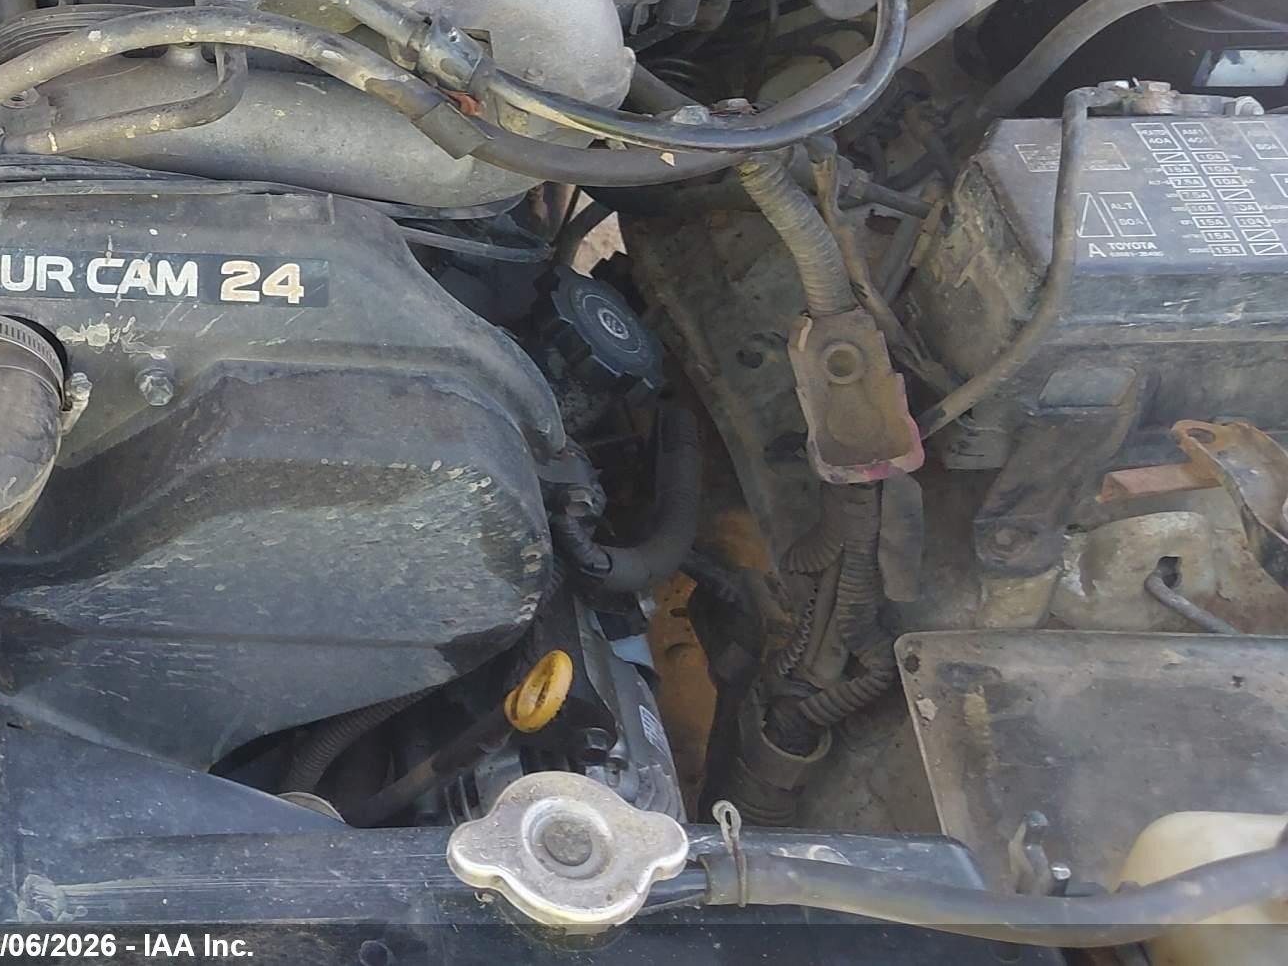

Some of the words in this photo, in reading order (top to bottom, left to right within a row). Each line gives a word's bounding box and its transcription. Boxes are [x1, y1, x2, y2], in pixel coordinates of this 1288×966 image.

[1207, 232, 1232, 240] 15A
[1088, 242, 1107, 258] A
[1107, 241, 1158, 250] TOYOTA
[86, 257, 199, 298] CAM
[219, 259, 305, 305] 24
